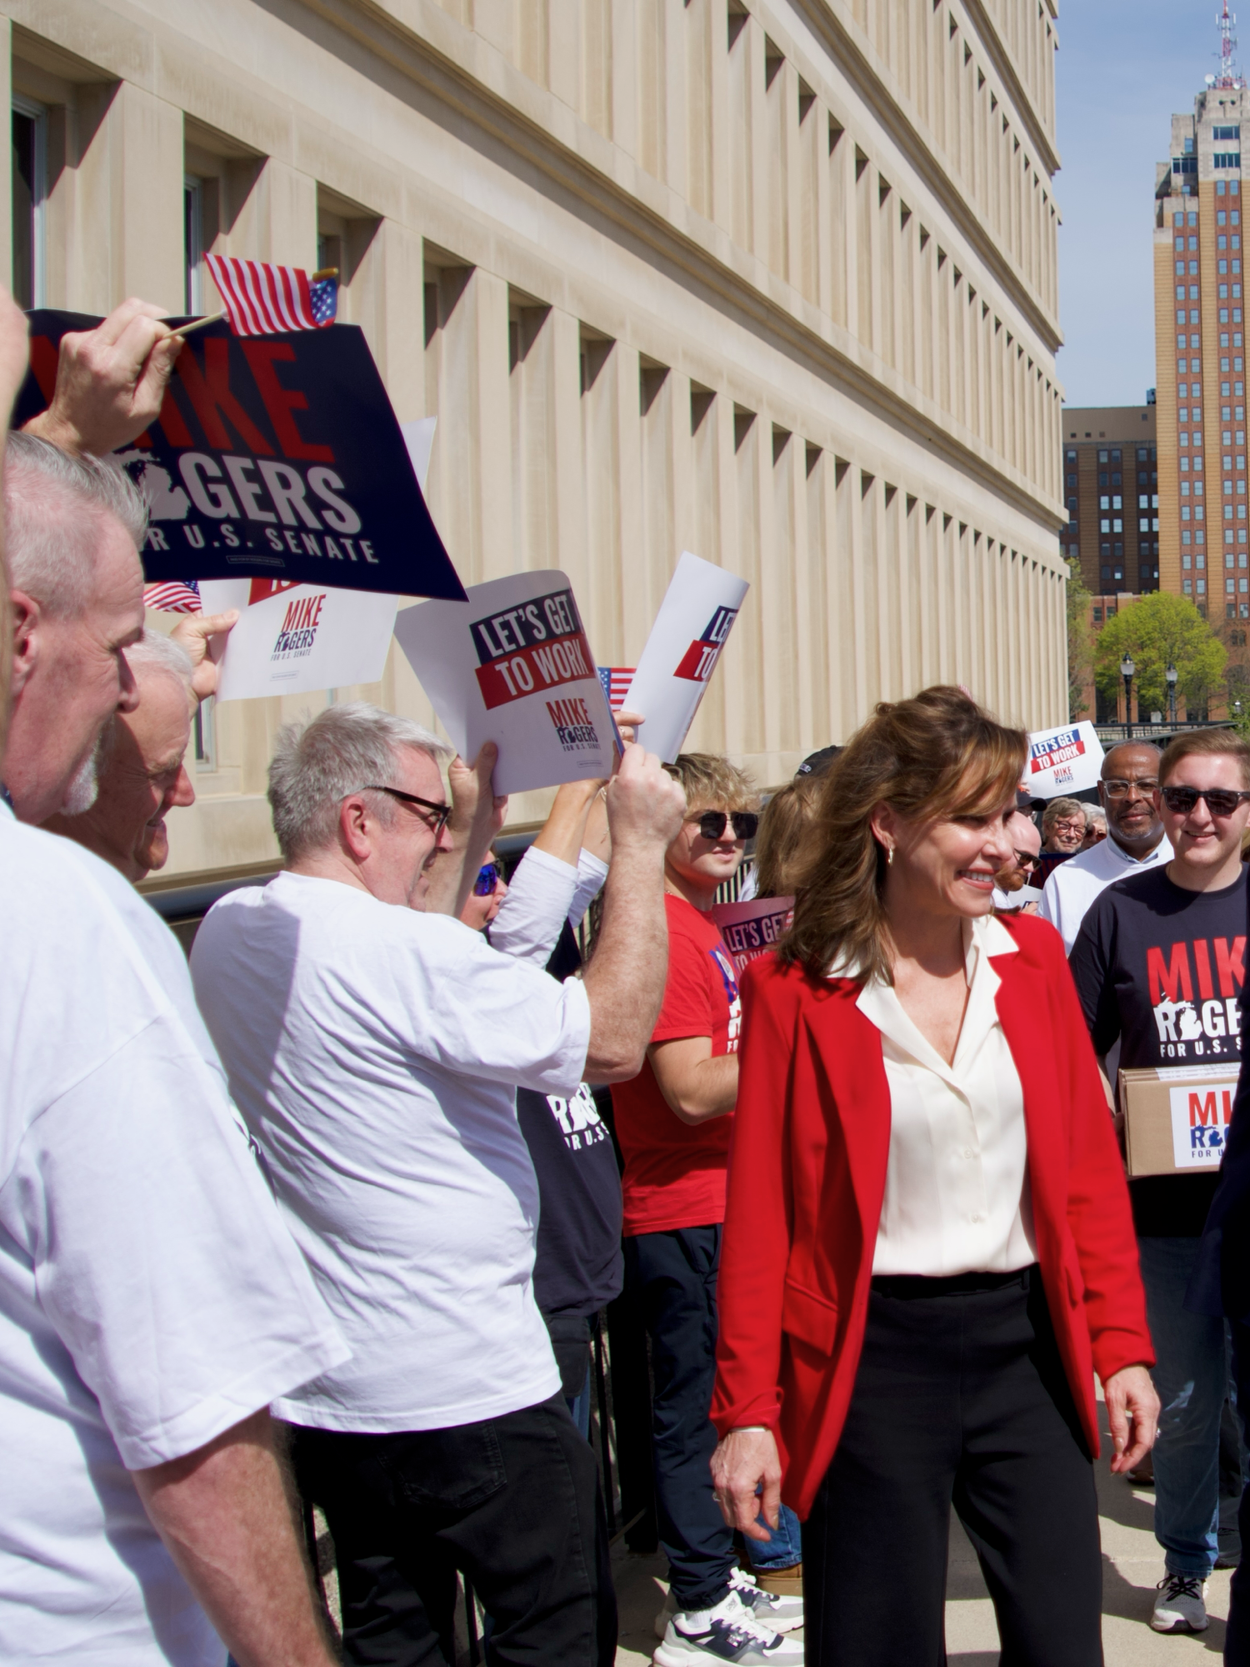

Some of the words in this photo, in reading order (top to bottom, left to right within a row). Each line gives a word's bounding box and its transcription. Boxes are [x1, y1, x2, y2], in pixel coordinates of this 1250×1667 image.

[183, 523, 254, 550] U.S.
[264, 527, 379, 563] SENATE
[281, 594, 326, 633] MIKE
[478, 604, 547, 658] LET'S
[544, 594, 576, 635] GET
[273, 628, 317, 653] ROGERS
[494, 656, 534, 696] TO
[531, 639, 589, 684] WORK
[545, 698, 593, 728] MIKE
[1033, 738, 1058, 757] LET'S
[1057, 732, 1076, 747] GET
[1037, 755, 1051, 770] TO
[1050, 744, 1080, 765] WORK
[1053, 766, 1072, 779] MIKE
[726, 921, 760, 952] LET'S
[1147, 935, 1247, 1006] MIK
[1160, 1043, 1187, 1057] FOR
[1195, 1039, 1228, 1055] U.S.
[1188, 1090, 1233, 1127] MI
[1191, 1149, 1212, 1158] FOR
